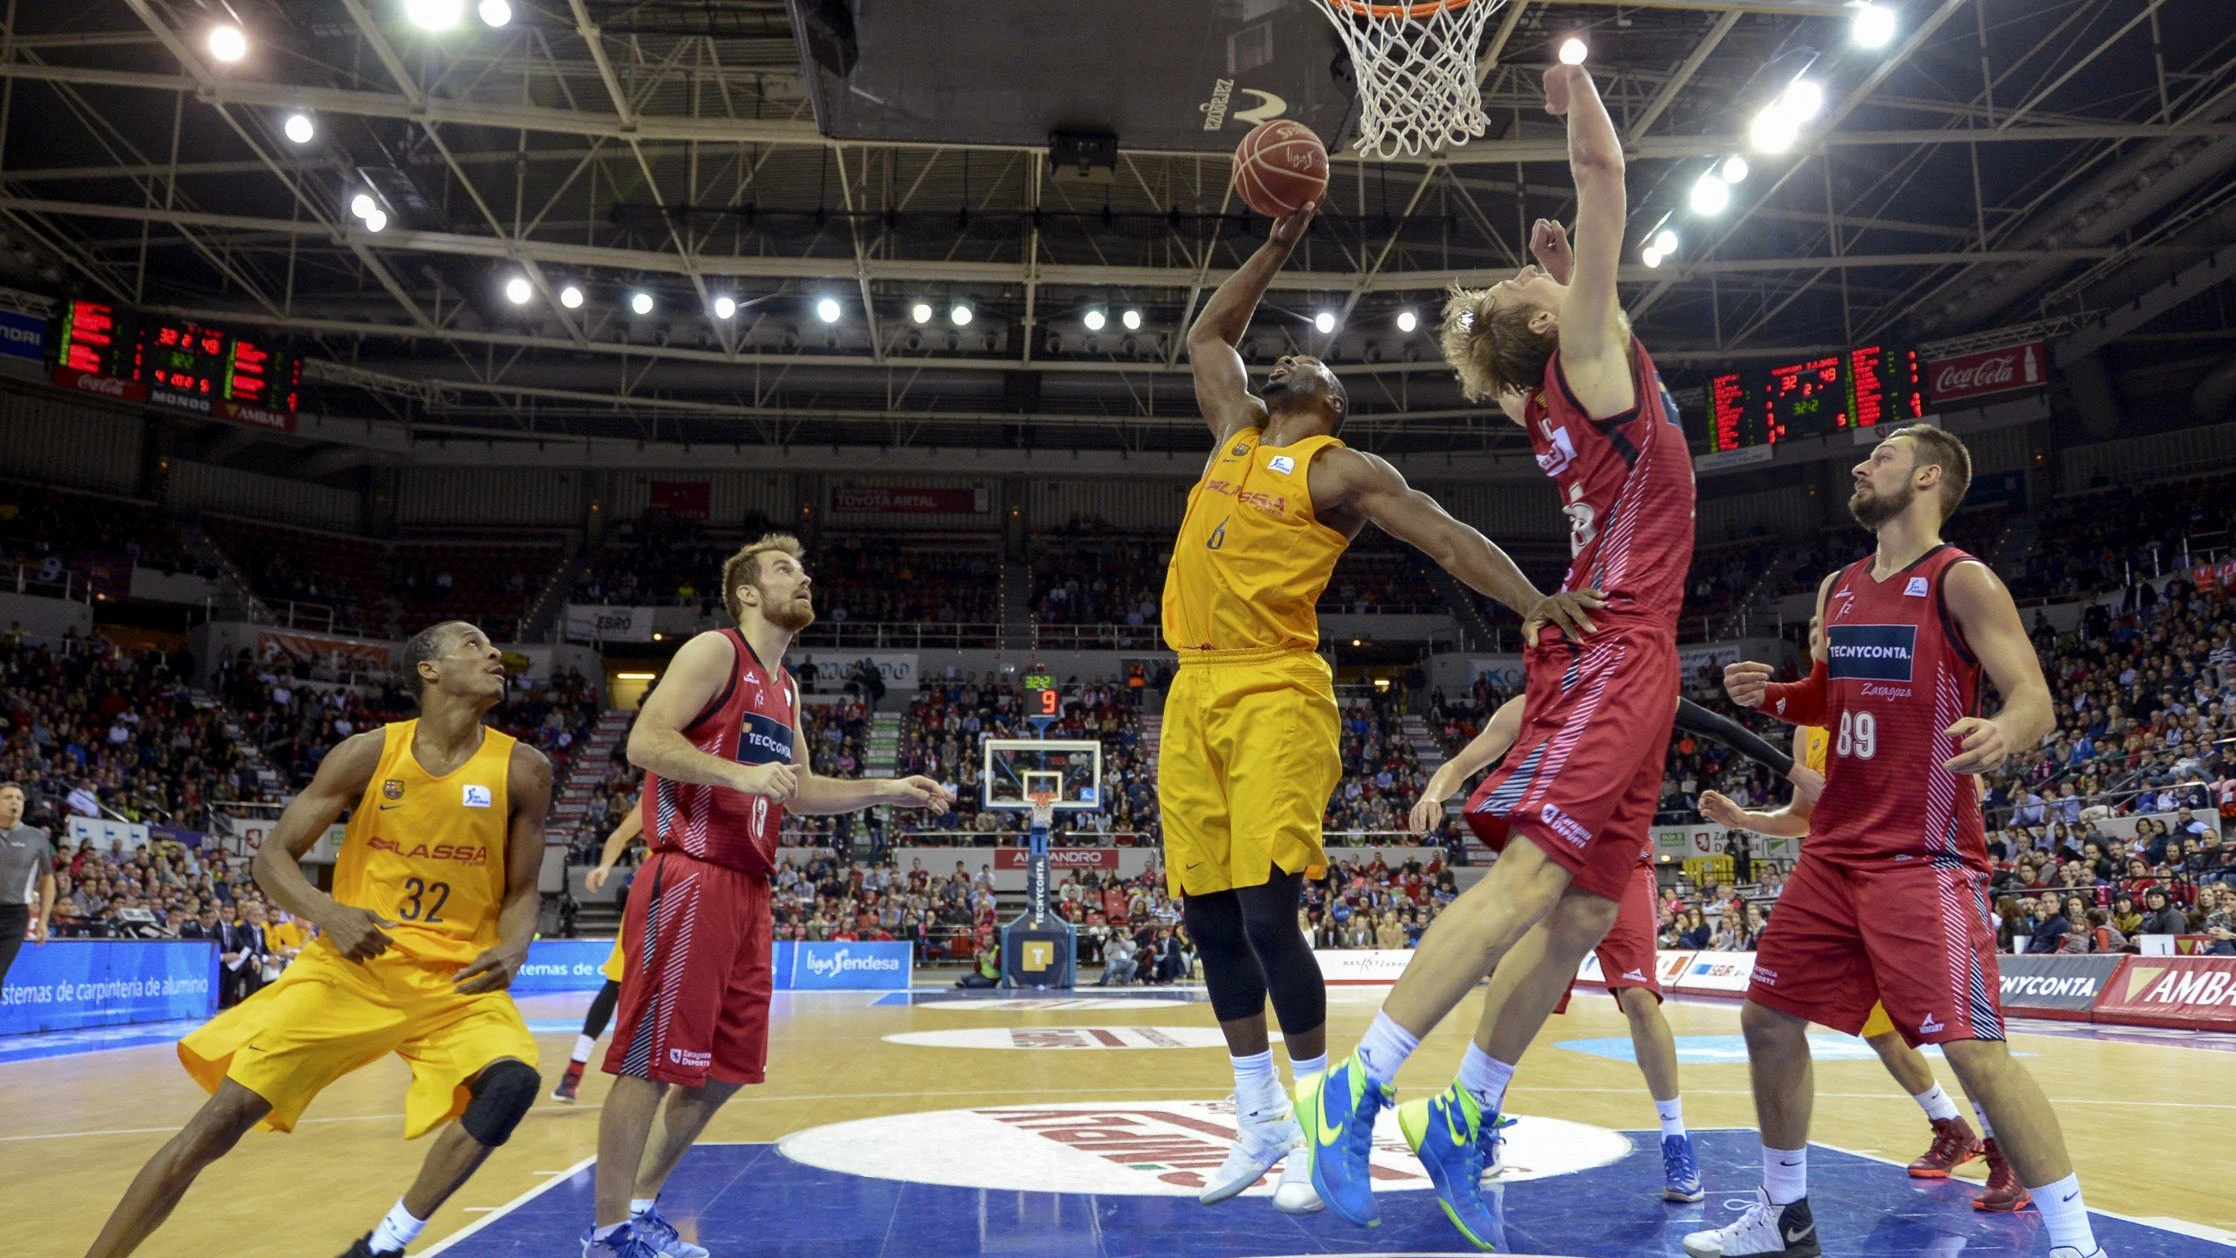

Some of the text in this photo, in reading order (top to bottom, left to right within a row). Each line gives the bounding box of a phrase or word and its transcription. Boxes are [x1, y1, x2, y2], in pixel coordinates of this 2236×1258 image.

[1199, 78, 1235, 132] zaragoza
[1781, 367, 1836, 391] 32 49
[1803, 382, 1812, 397] 2
[152, 391, 211, 411] MONDO
[239, 408, 285, 428] AMBAR
[838, 495, 937, 508] TOYOTA ARTAL
[1206, 514, 1232, 550] 6
[1042, 690, 1056, 714] 9
[1861, 682, 1913, 702] Zaragoza
[1836, 708, 1876, 760] 89
[394, 840, 487, 861] LASSA
[1013, 851, 1102, 863] AANDRO
[400, 877, 450, 923] 32
[572, 962, 593, 976] de
[56, 979, 74, 1003] de
[145, 975, 160, 997] de
[162, 974, 209, 996] aluminio
